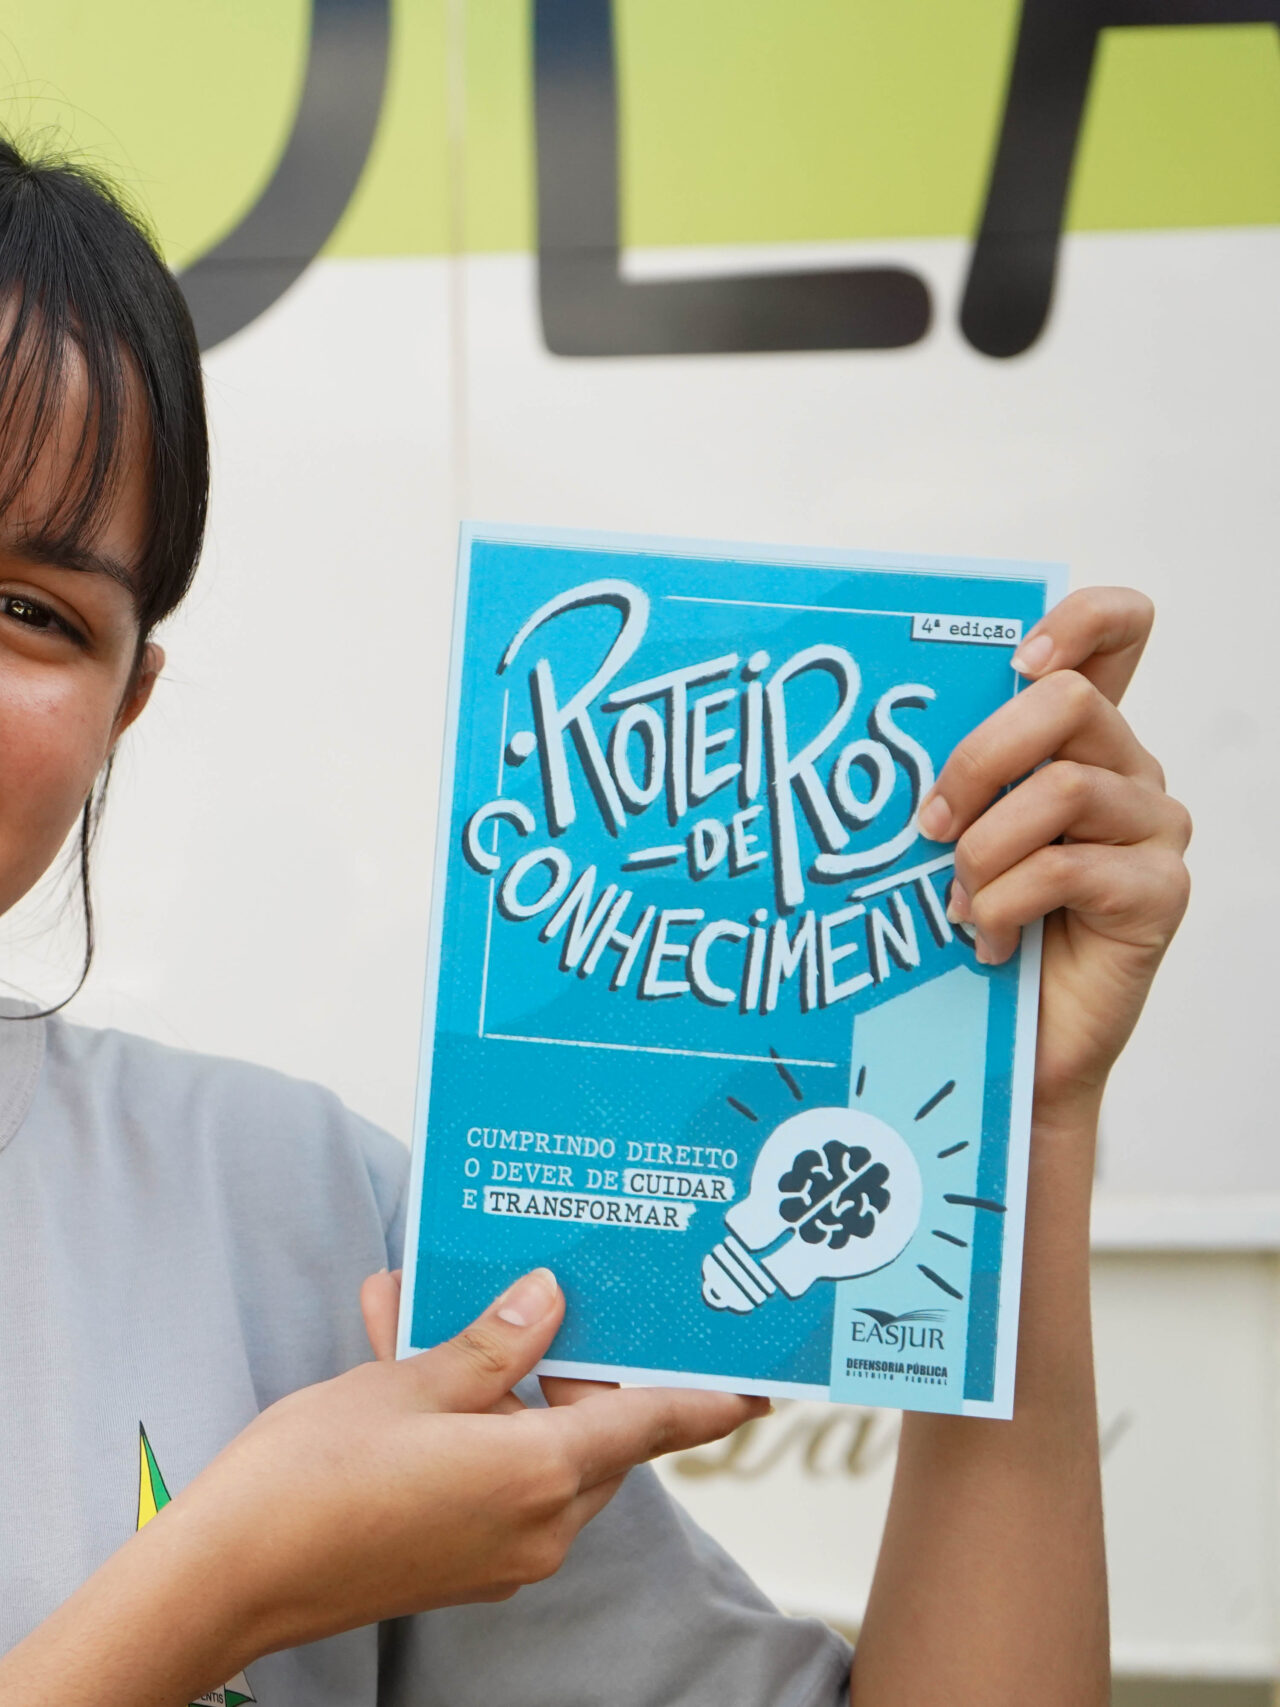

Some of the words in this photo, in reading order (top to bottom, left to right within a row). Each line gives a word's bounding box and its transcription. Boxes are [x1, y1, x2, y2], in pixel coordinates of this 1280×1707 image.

[949, 621, 1016, 640] edição
[689, 805, 769, 880] DE
[467, 1127, 616, 1159] CUMPRINDO
[627, 1141, 738, 1170] DIREITO
[464, 1158, 480, 1178] O
[491, 1160, 574, 1188] DEVER
[586, 1168, 619, 1190] DE
[630, 1173, 728, 1200] CUIDAR
[462, 1188, 478, 1210] E
[490, 1191, 680, 1228] TRANSFORMAR
[851, 1321, 945, 1353] EASJUR
[846, 1358, 905, 1374] DEFENSORIA
[906, 1362, 948, 1378] PÚBLICA
[846, 1370, 895, 1381] DISTRITO
